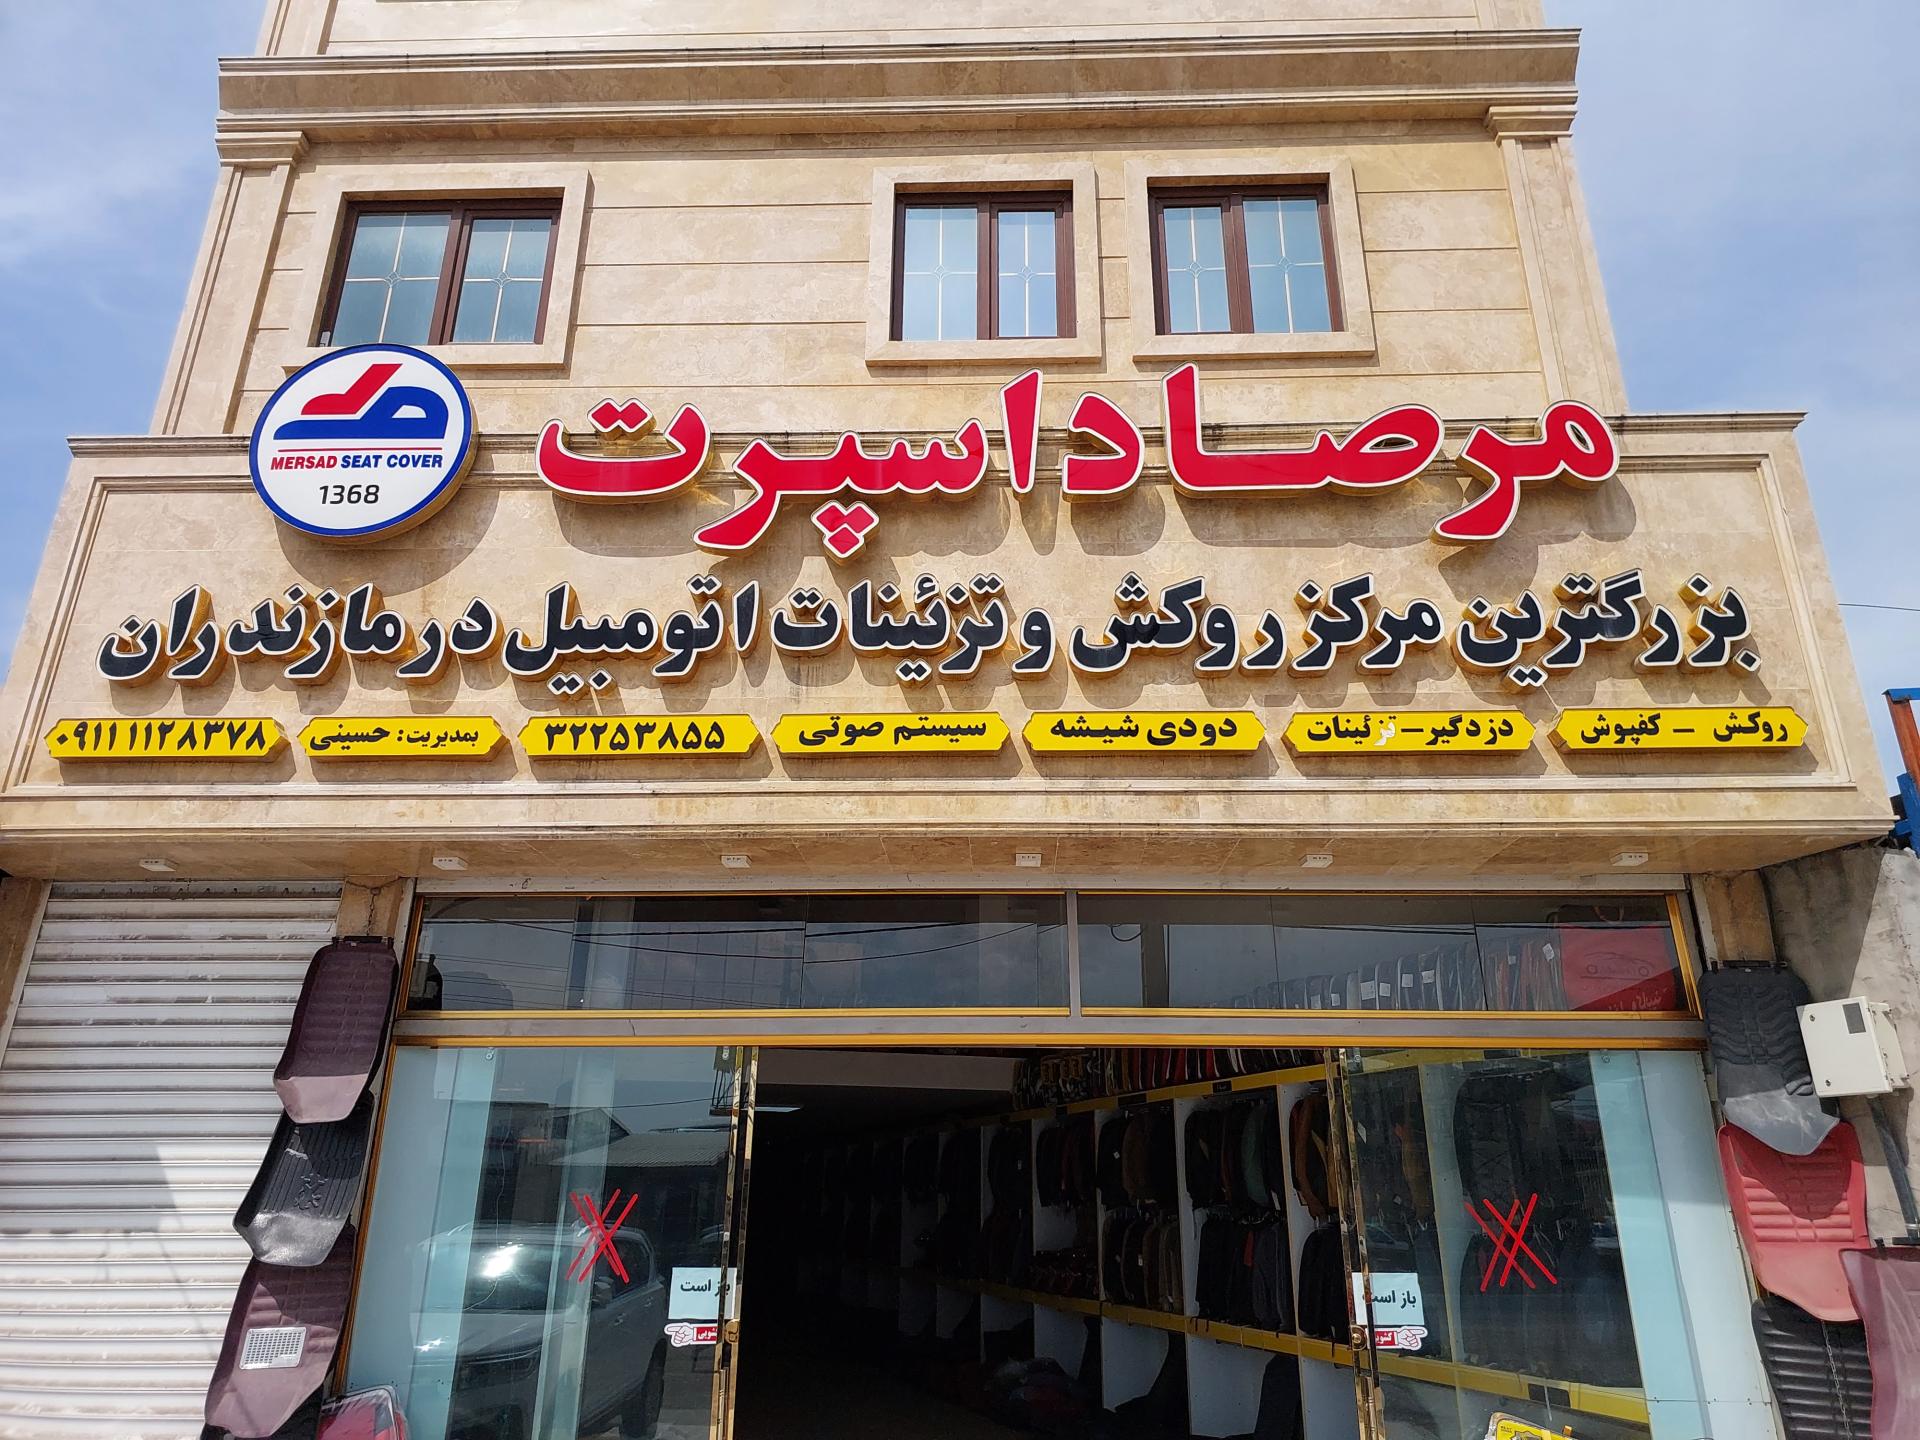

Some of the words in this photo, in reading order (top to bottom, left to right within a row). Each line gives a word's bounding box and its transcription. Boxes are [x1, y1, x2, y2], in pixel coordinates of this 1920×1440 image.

[270, 455, 338, 470] MERSAD
[340, 454, 382, 469] SEAT
[386, 454, 443, 469] COVER
[535, 368, 1044, 559] اسپرت
[1061, 362, 1621, 541] مرصاد
[319, 484, 380, 505] 1368
[99, 582, 403, 681] مازندران
[398, 597, 494, 678] در
[503, 574, 760, 695] اتومبیل
[771, 573, 1008, 681] تزئینات
[1069, 572, 1287, 674] روکش
[1291, 573, 1445, 671] مرکز
[1457, 569, 1761, 686] بزرگترین
[1012, 607, 1056, 672] و
[309, 724, 391, 751] حسینی
[544, 721, 725, 751] ۳۲۲۵۳۸۵۵
[798, 715, 884, 746] صوتی
[893, 716, 987, 746] سیستم
[1050, 713, 1139, 744] شیشه
[1146, 718, 1238, 746] دودی
[1306, 714, 1397, 746] تزئینات
[1425, 714, 1514, 746] دزدگیر
[1580, 713, 1661, 745] کفپوش
[1713, 711, 1788, 742] روکش
[680, 1279, 711, 1292] است
[1400, 1290, 1417, 1309] باز
